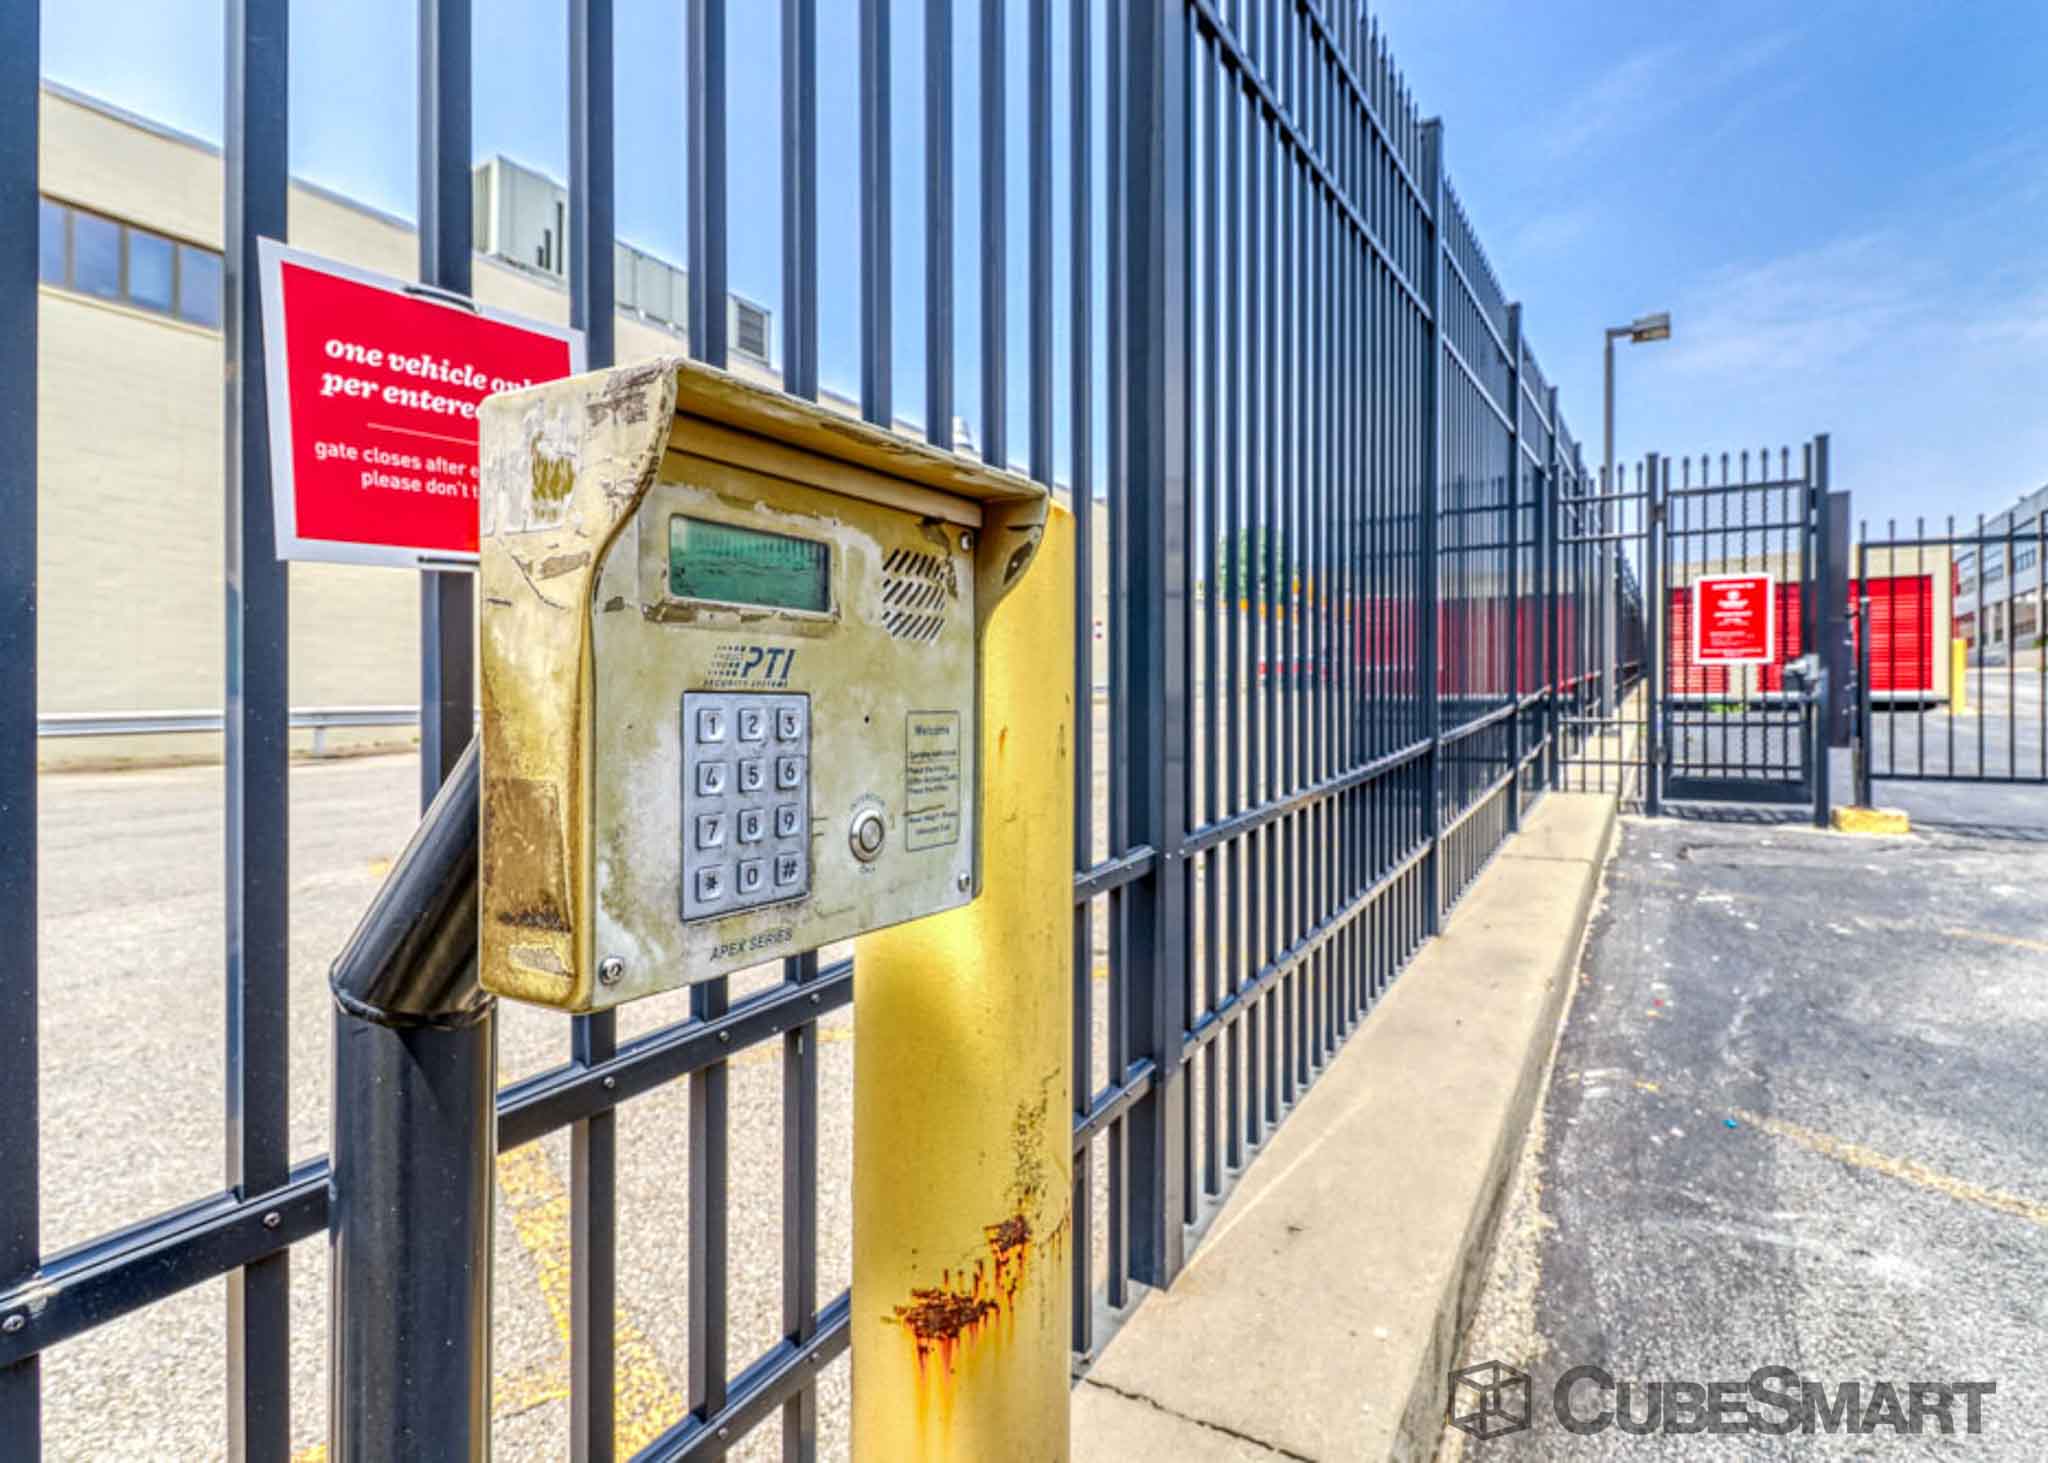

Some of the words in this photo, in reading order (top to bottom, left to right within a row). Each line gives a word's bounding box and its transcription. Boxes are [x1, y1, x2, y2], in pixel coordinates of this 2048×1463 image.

[325, 339, 383, 367] one
[387, 354, 487, 390] vehicle
[320, 372, 379, 398] per
[383, 386, 480, 419] entere
[314, 441, 358, 460] gate
[362, 447, 422, 470] closes
[425, 456, 466, 475] after
[360, 469, 422, 492] please
[425, 477, 468, 498] don't
[740, 646, 795, 678] PTI
[709, 716, 717, 735] 1
[748, 715, 759, 734] 2
[785, 716, 795, 735] 3
[705, 767, 718, 786] 4
[748, 766, 759, 785] 5
[784, 761, 795, 781] 6
[707, 820, 718, 841] 7
[747, 816, 758, 834] 8
[784, 812, 794, 831] 9
[747, 868, 758, 885] 0
[783, 860, 797, 878] #
